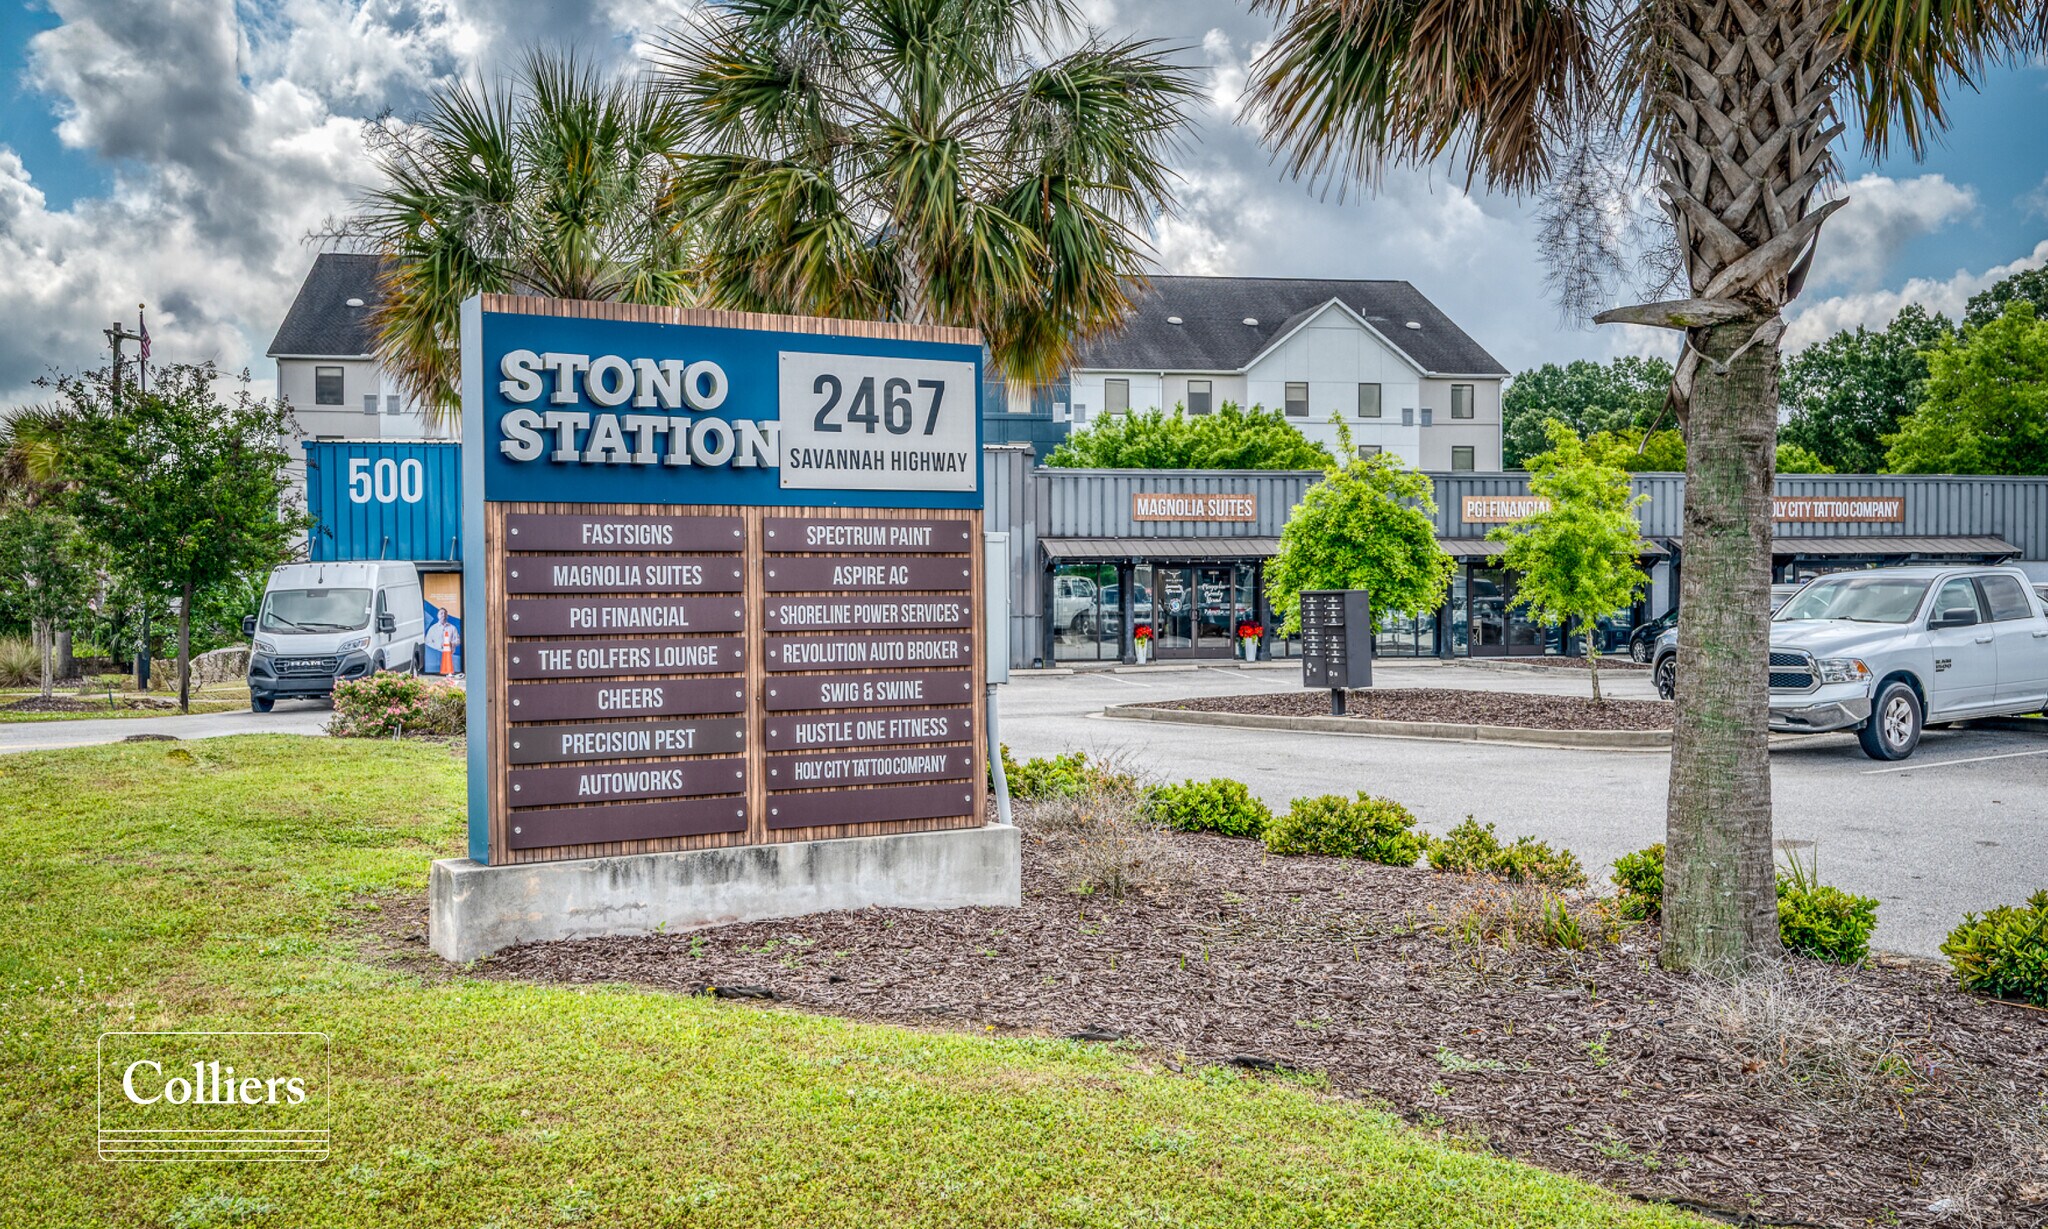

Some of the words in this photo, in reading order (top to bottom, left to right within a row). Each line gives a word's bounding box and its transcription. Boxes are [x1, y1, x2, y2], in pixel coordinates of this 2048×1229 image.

[500, 349, 728, 411] STONO
[813, 374, 945, 435] 2467
[500, 408, 780, 467] STATION
[790, 448, 885, 471] SAVANNAH
[891, 450, 968, 473] HIGHWAY
[349, 458, 423, 503] 500
[1137, 498, 1205, 516] MAGNOLIA
[1208, 499, 1253, 517] SUITES
[1467, 501, 1486, 518] PGI
[1788, 501, 1812, 518] CITY
[583, 523, 673, 545] FASTSIGNS
[807, 526, 886, 545] SPECTRUM
[890, 527, 932, 546] PAINT
[553, 566, 642, 586] MAGNOLIA
[646, 565, 702, 585] SUITES
[833, 566, 885, 585] ASPIRE
[889, 566, 908, 584] AC
[570, 607, 597, 628] PGI
[602, 606, 689, 627] FINANCIAL
[780, 605, 851, 625] SHORELINE
[854, 604, 898, 623] POWER
[901, 603, 959, 622] SERVICES
[538, 650, 572, 670] THE
[577, 647, 651, 669] GOLFERS
[655, 645, 718, 667] LOUNGE
[783, 642, 867, 663] REVOLUTION
[870, 642, 904, 661] AUTO
[907, 641, 958, 660] BROKER
[598, 687, 664, 710] CHEERS
[821, 683, 859, 703] SWIG
[863, 682, 874, 701] &
[877, 680, 923, 700] SWINE
[796, 722, 852, 744] HUSTLE
[857, 720, 886, 740] ONE
[889, 717, 948, 738] FITNESS
[562, 730, 650, 755] PRECISION
[655, 729, 696, 750] PEST
[795, 761, 823, 780] HOLY
[824, 760, 850, 779] CITY
[579, 769, 683, 796] AUTOWORKS
